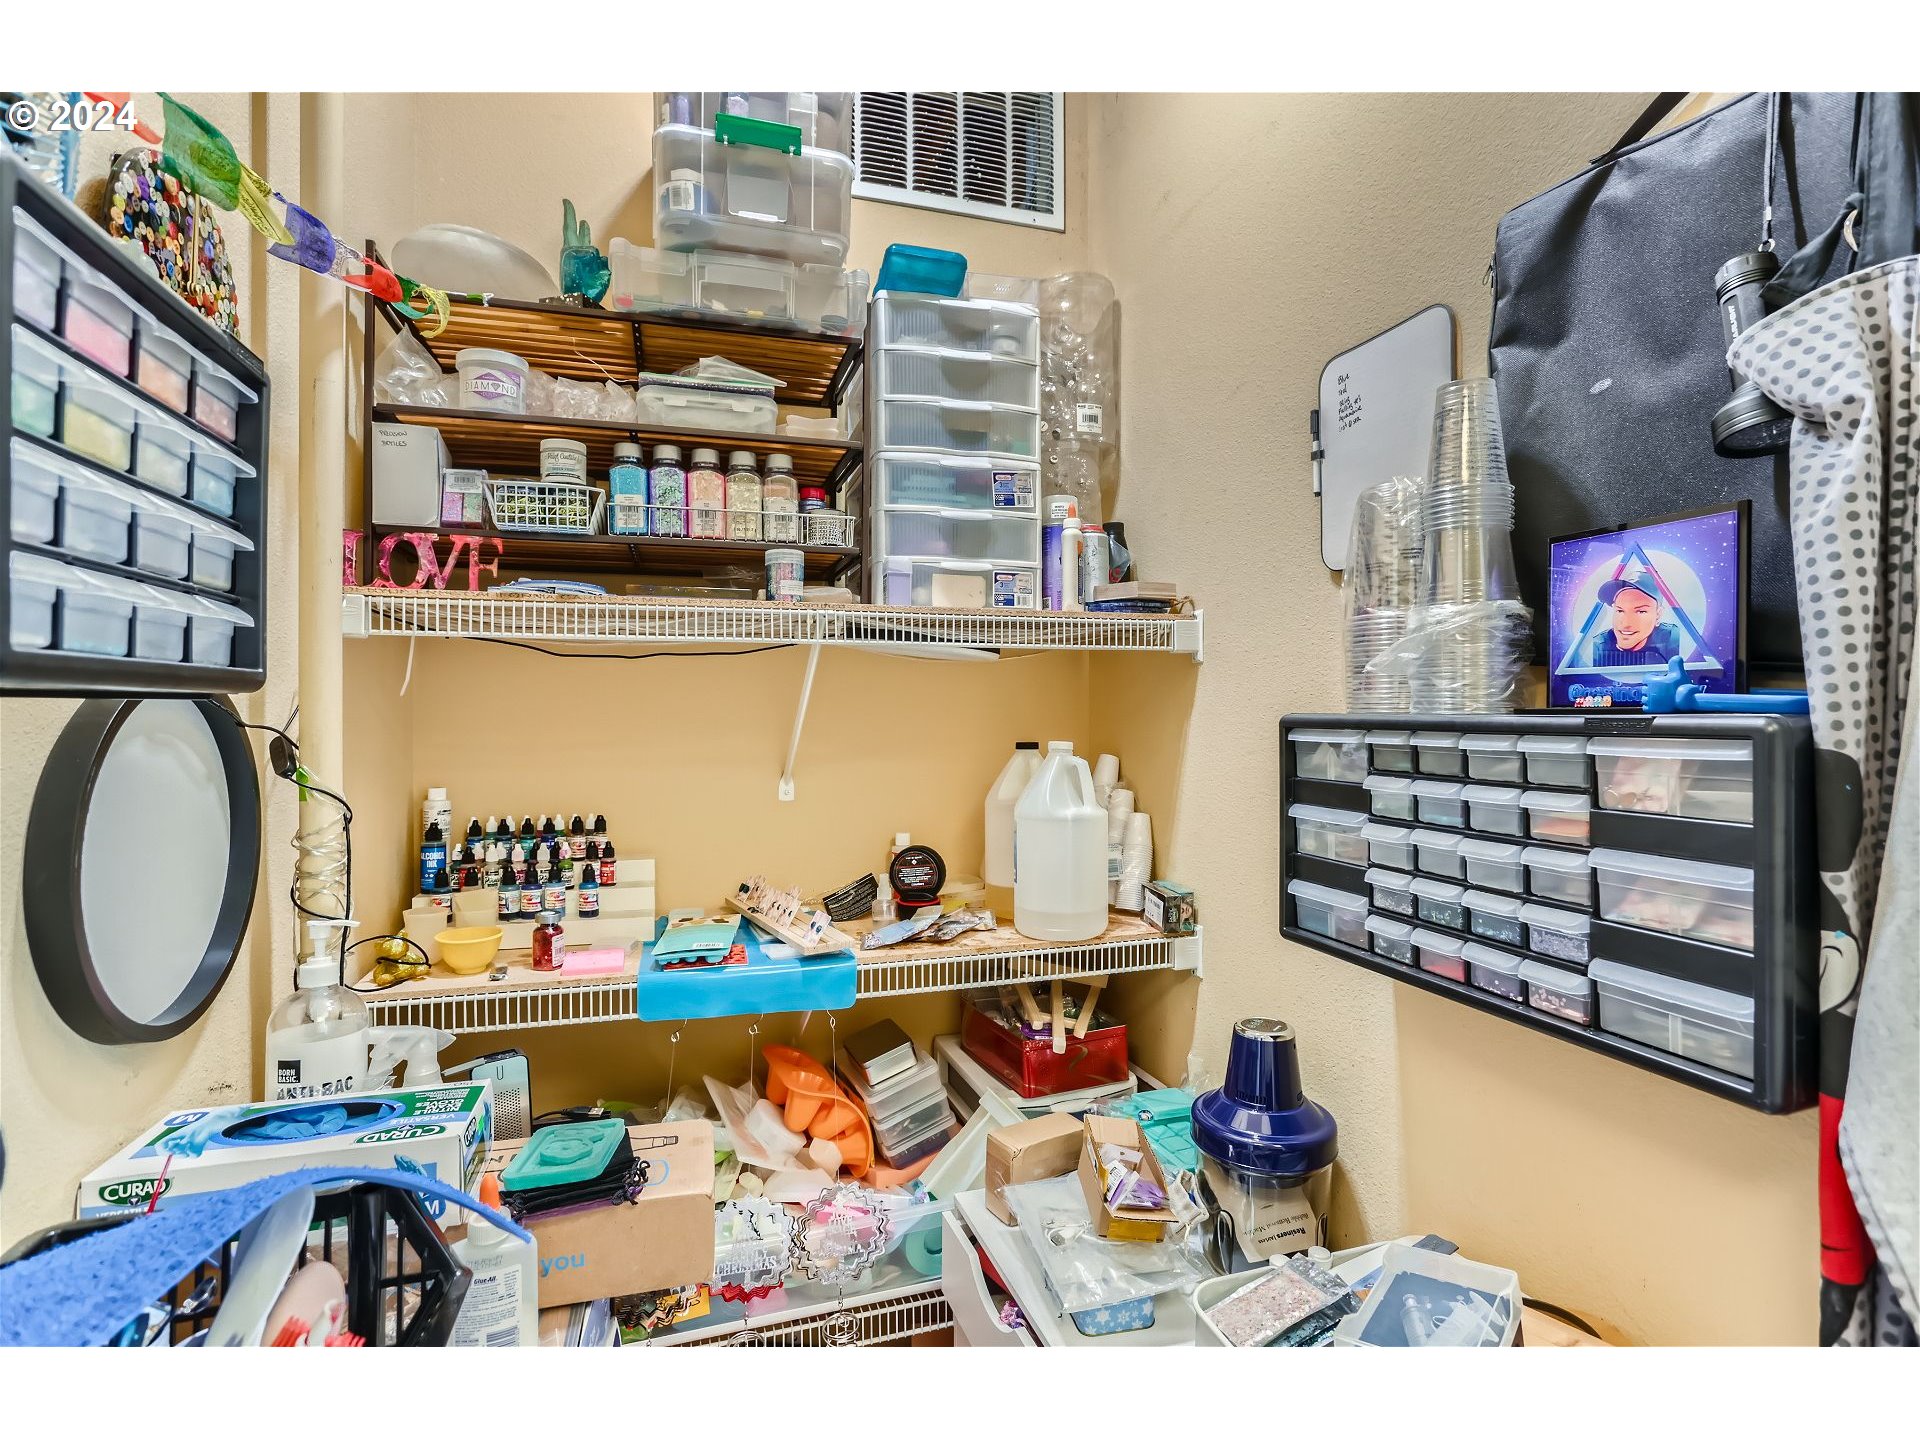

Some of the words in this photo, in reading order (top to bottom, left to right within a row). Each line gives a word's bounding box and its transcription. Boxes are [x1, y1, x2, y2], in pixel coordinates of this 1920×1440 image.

[426, 860, 438, 868] INK
[278, 1068, 296, 1077] BORN
[277, 1075, 353, 1101] ANTI-BAC
[363, 1125, 441, 1144] CURAD
[104, 1180, 166, 1201] CURAD
[1276, 1226, 1306, 1239] Resiners
[540, 1253, 585, 1278] you
